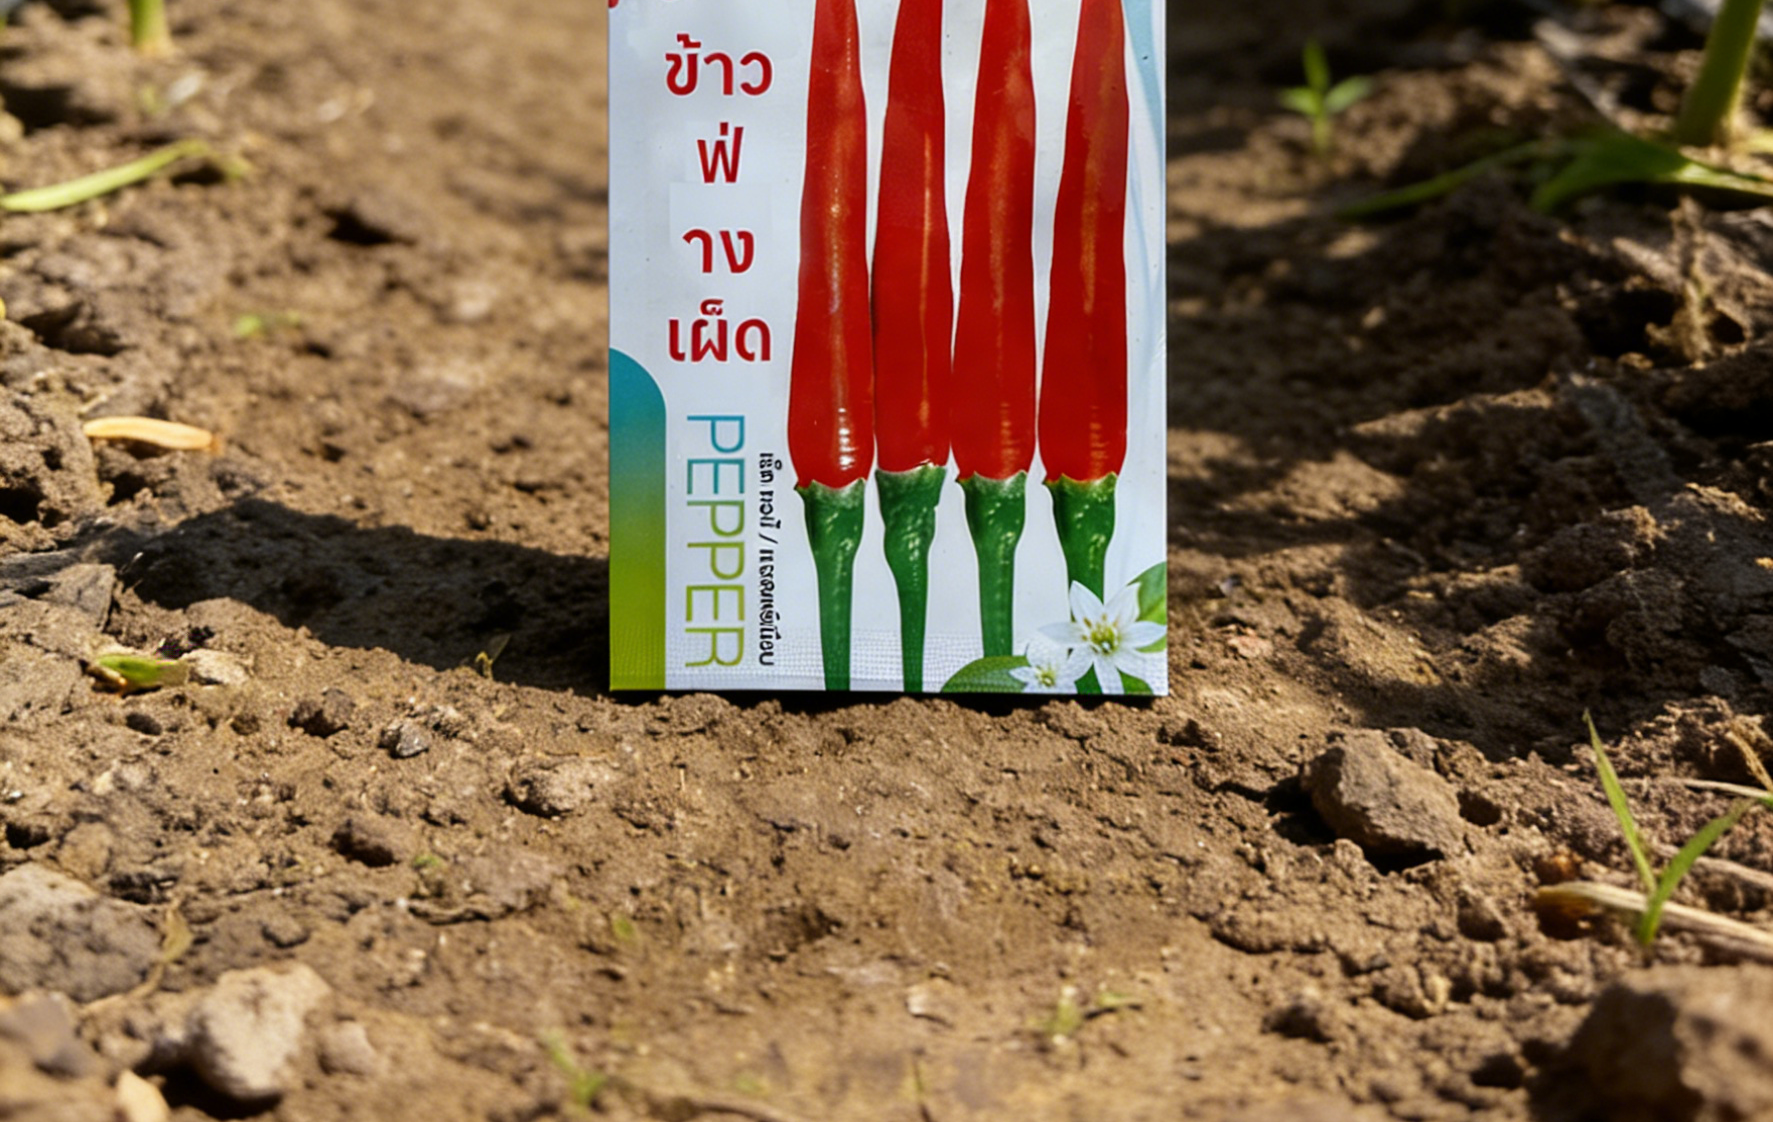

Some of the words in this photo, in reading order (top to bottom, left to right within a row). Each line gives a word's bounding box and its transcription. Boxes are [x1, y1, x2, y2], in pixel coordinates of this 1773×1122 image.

[666, 34, 772, 95] ข้าว
[697, 122, 743, 183] ฟ่
[669, 299, 771, 362] เผ็ด
[685, 414, 745, 667] PEPPER
